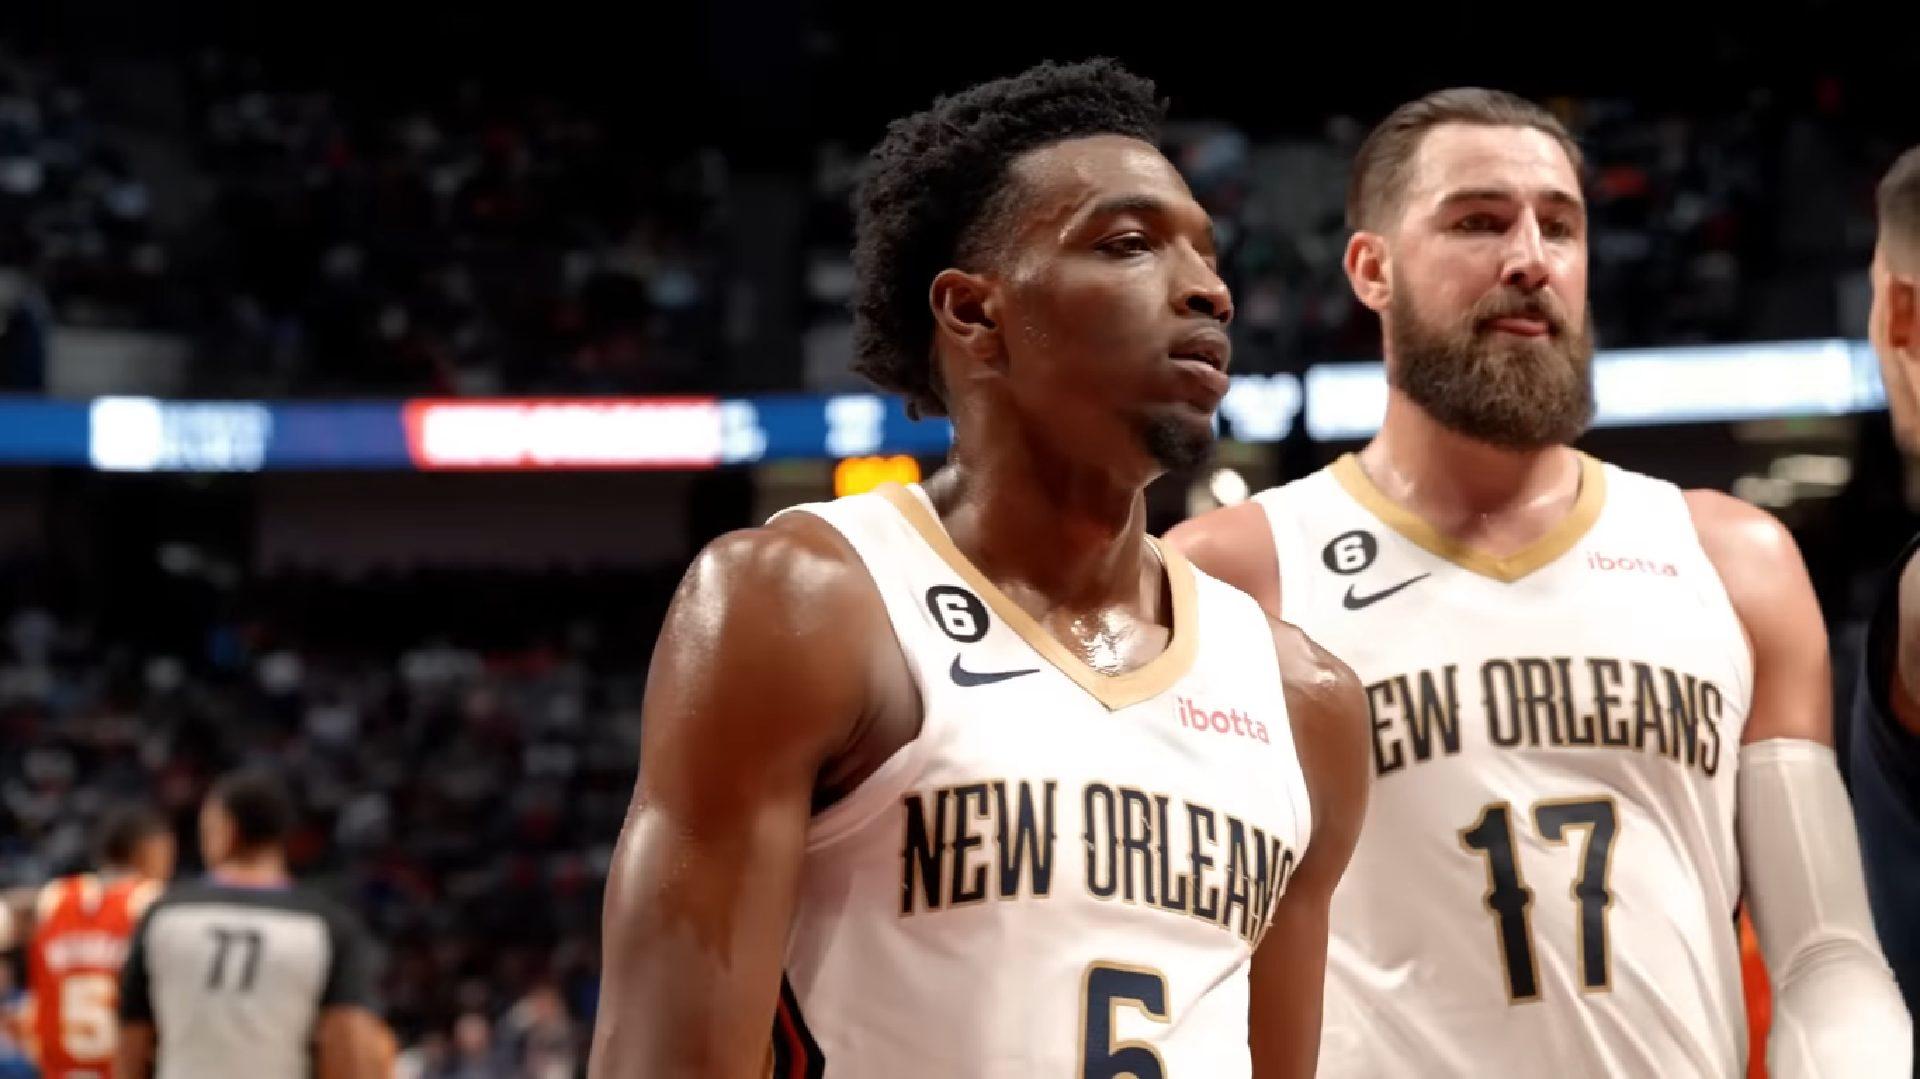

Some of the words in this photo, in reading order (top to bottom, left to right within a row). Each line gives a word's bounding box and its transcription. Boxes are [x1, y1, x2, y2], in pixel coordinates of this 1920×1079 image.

[1331, 533, 1369, 573] 6
[1586, 550, 1678, 577] ibotta
[934, 592, 980, 638] 6
[1177, 697, 1270, 745] ibotta
[1364, 663, 1461, 778] EW
[1480, 657, 1724, 778] ORLEANS
[898, 779, 1058, 918] NEW
[1458, 794, 1621, 1005] 17
[206, 927, 263, 993] 77
